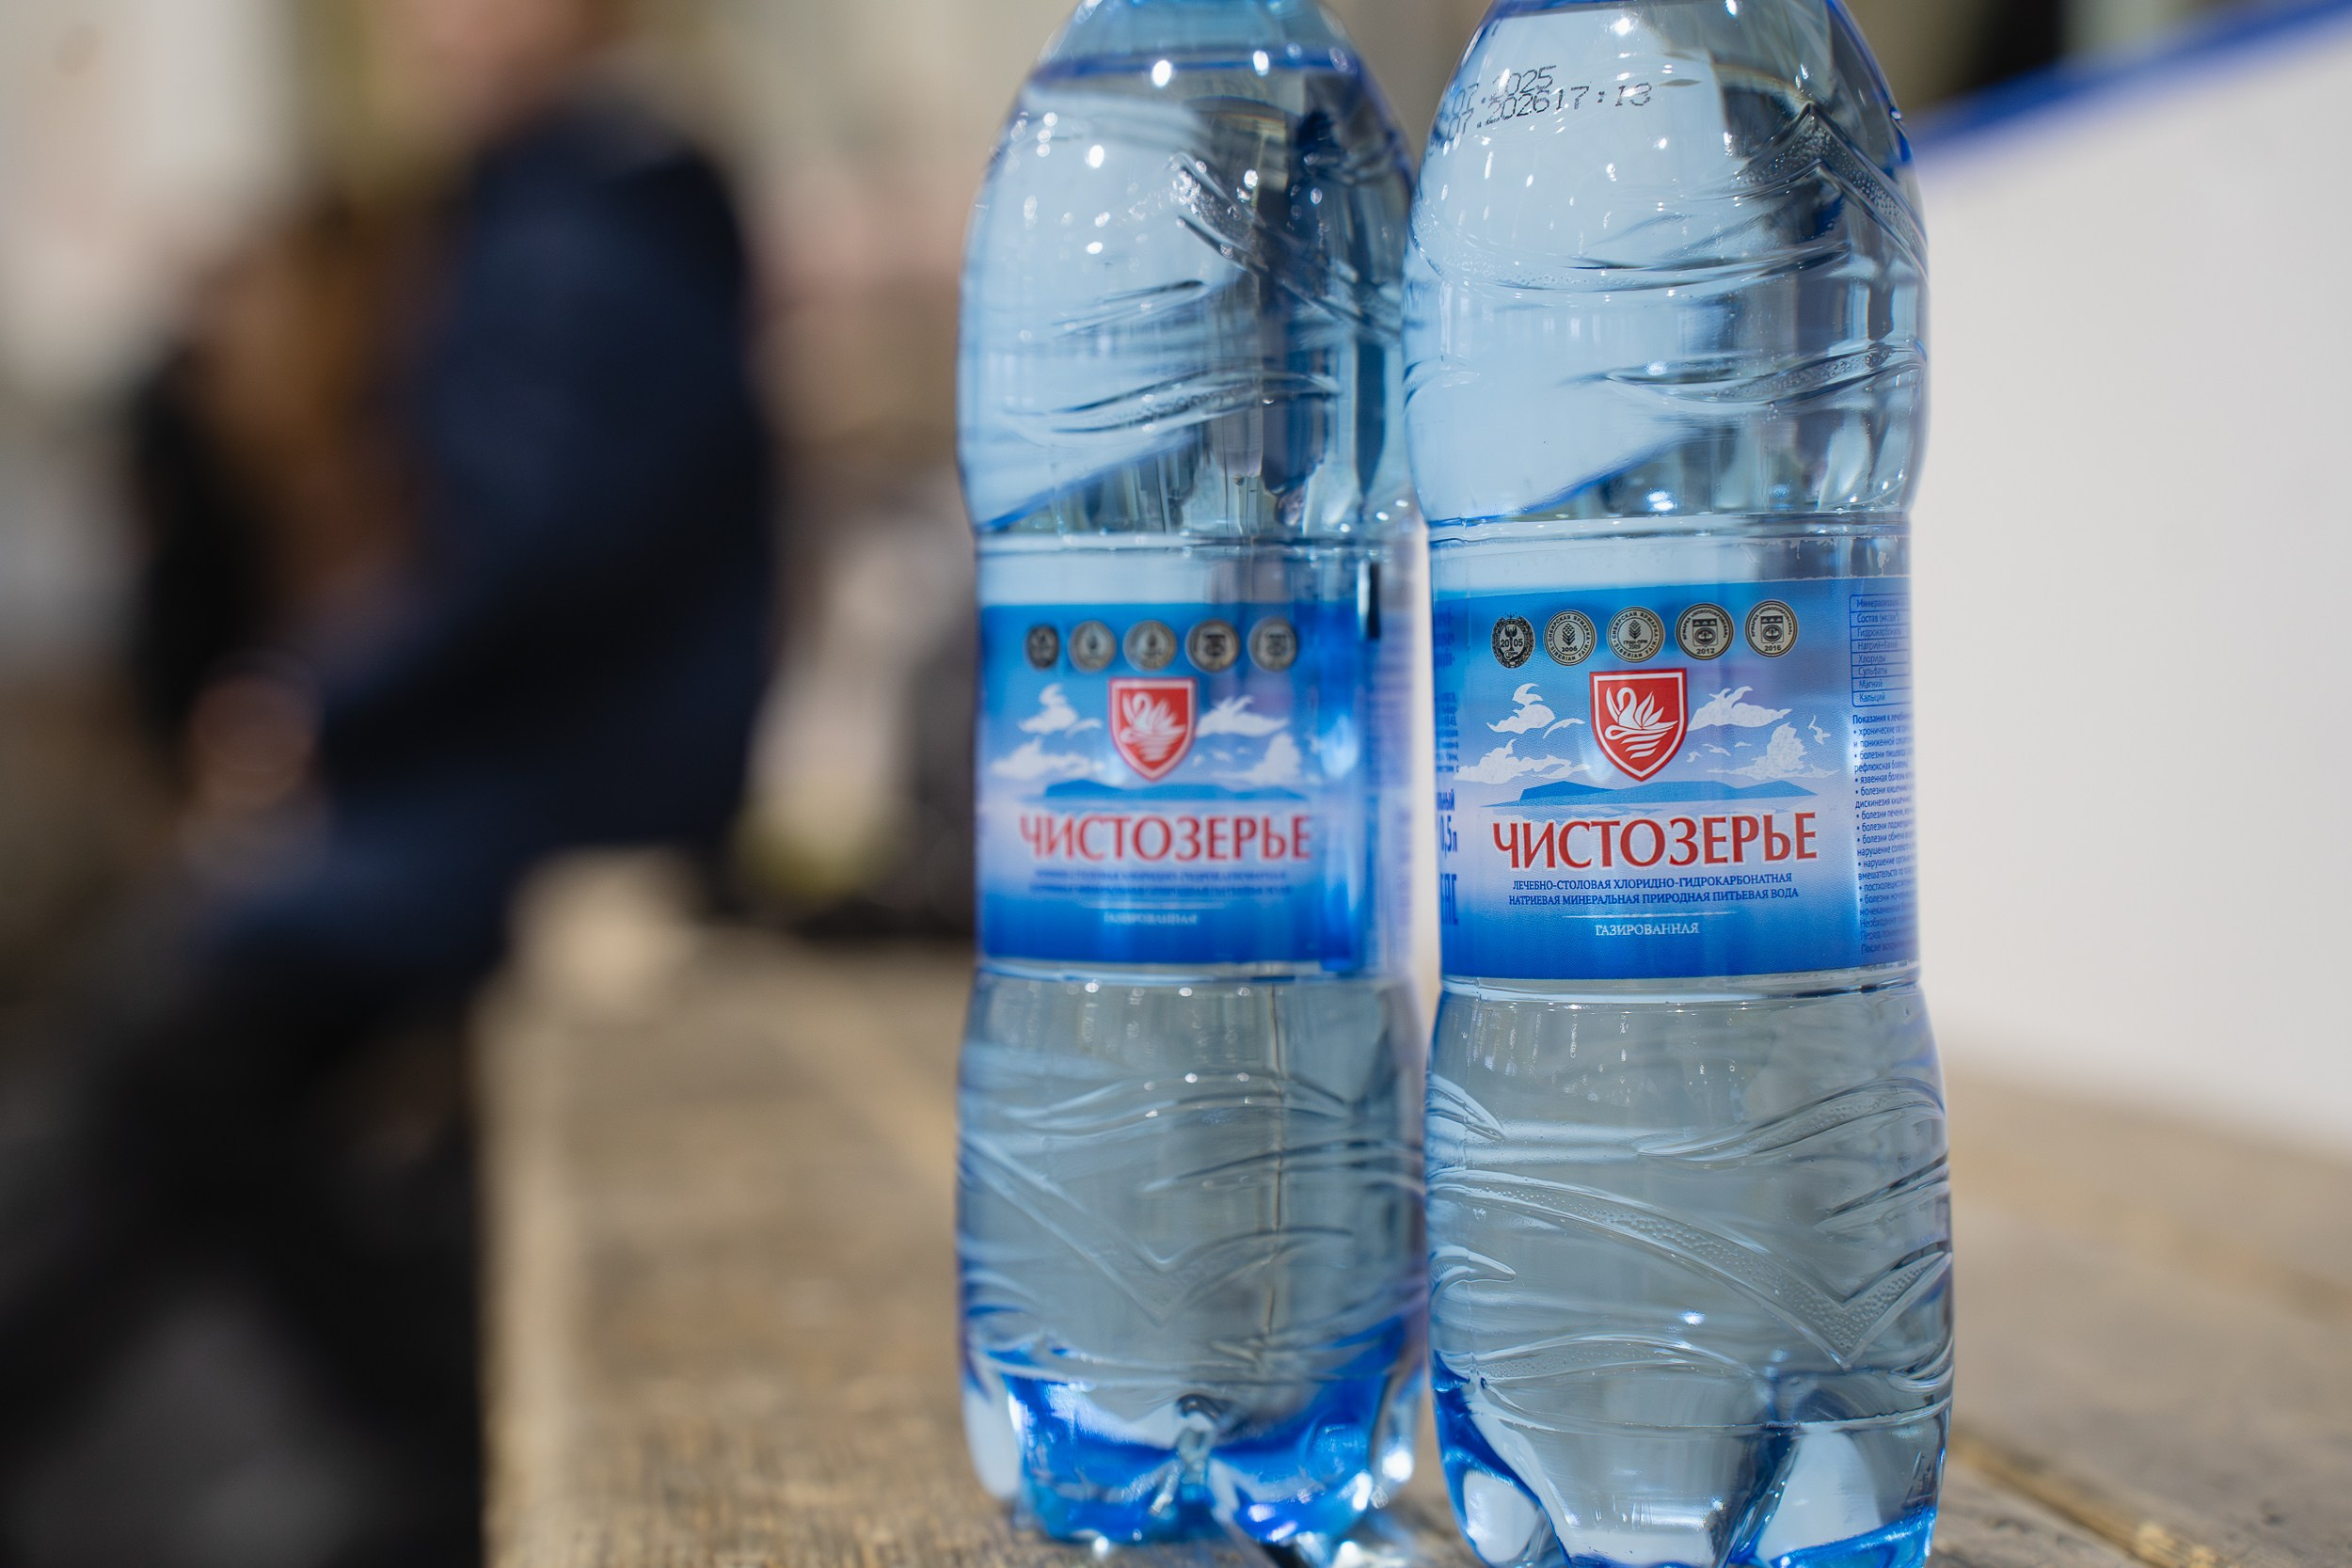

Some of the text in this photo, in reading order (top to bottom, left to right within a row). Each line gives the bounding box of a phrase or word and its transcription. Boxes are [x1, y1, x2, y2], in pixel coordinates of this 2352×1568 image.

[1856, 613, 1878, 624] Состав
[1858, 666, 1888, 677] Сульфаты
[1859, 679, 1883, 689] Магний
[1859, 692, 1885, 703] Кальций
[1852, 714, 1886, 724] Показания
[1859, 751, 1885, 760] болезни
[1860, 786, 1886, 796] болезни
[1854, 798, 1891, 810] дискинезия
[1861, 810, 1887, 820] болезни
[1862, 822, 1887, 832] болезни
[1019, 815, 1311, 863] ЧИСТОЗЕРЬЕ
[1492, 812, 1818, 869] ЧИСТОЗЕРЬЕ
[1862, 833, 1887, 844] болезни
[1856, 846, 1891, 858] нарушение
[1863, 857, 1896, 869] нарушение
[1512, 873, 1793, 891] ЛЕЧЕБНО-СТОЛОВАЯ ХЛОРИДНО-ГИДРОКАРБОНАТНАЯ
[1508, 887, 1800, 906] НАТРИЕВАЯ МИНЕРАЛЬНАЯ ПРИРОДНАЯ ПИТЬЕВАЯ ВОДА
[1595, 922, 1701, 936] ГАЗИРОВАННАЯ
